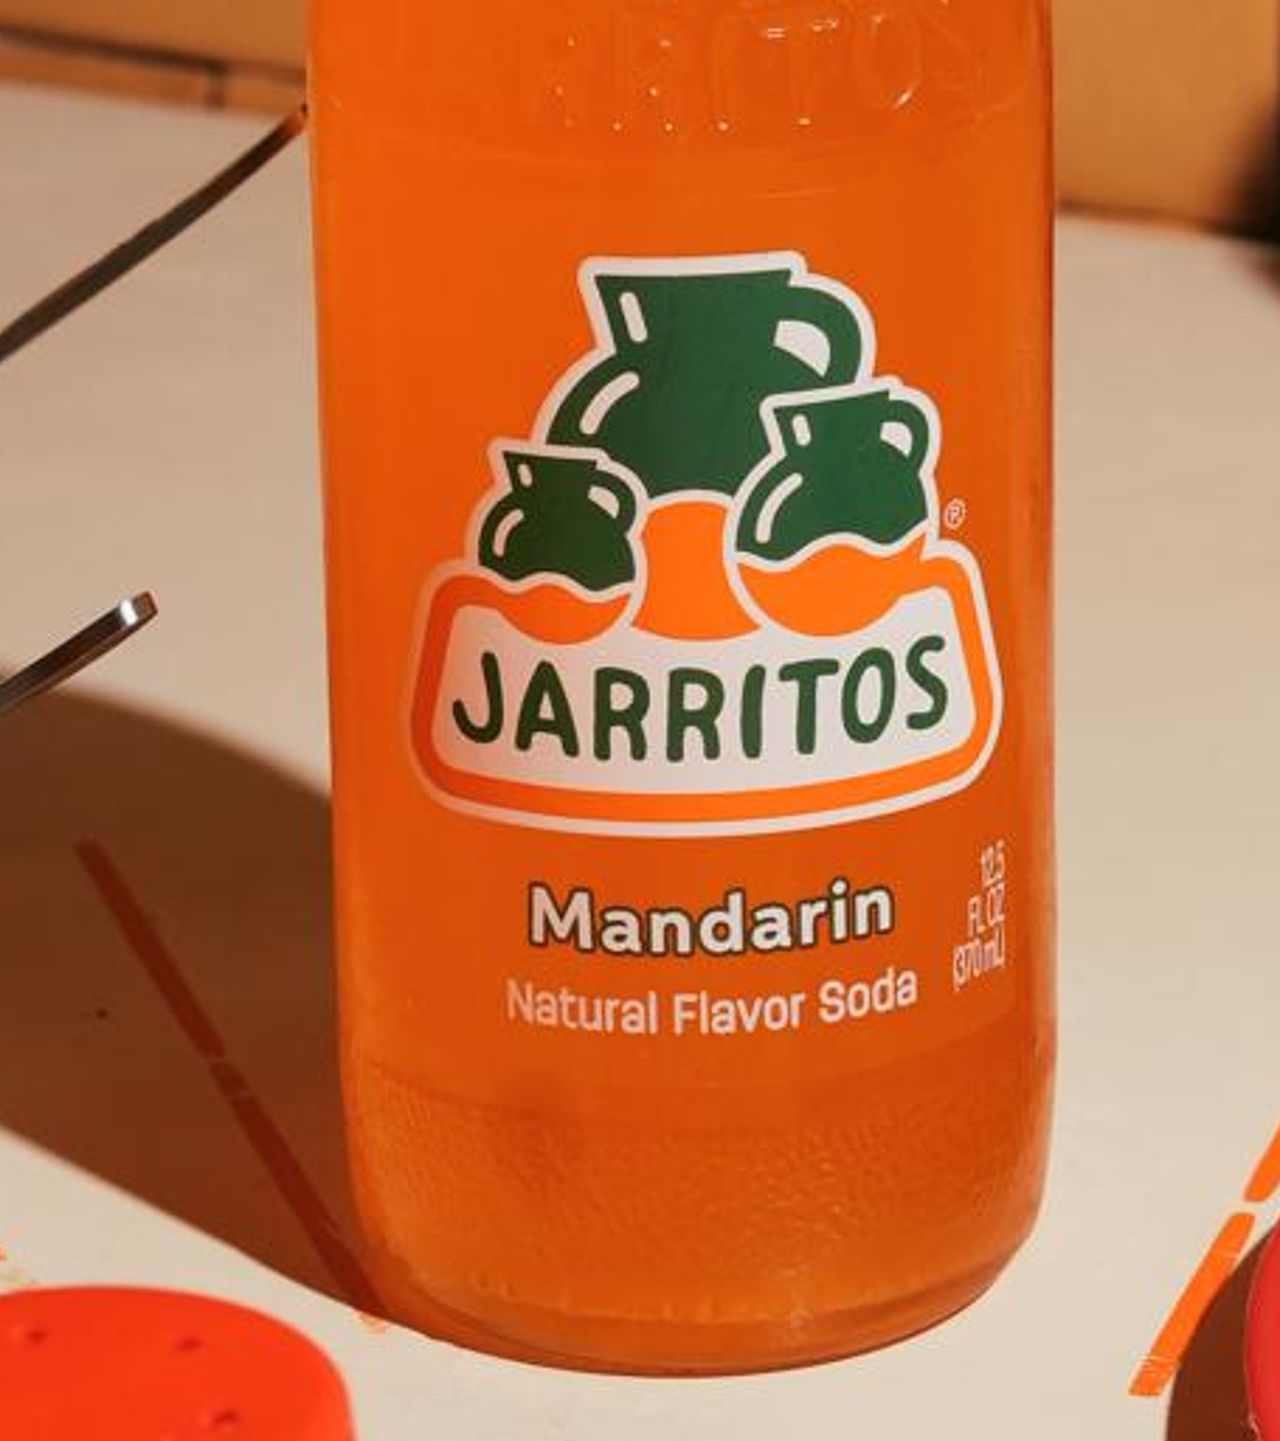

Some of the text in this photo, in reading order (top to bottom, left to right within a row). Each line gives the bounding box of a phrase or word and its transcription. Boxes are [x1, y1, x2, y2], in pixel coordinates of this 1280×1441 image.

[452, 634, 949, 763] JARRITOS
[527, 877, 894, 956] Mandarin
[505, 965, 919, 1036] Natural Flavor Soda
